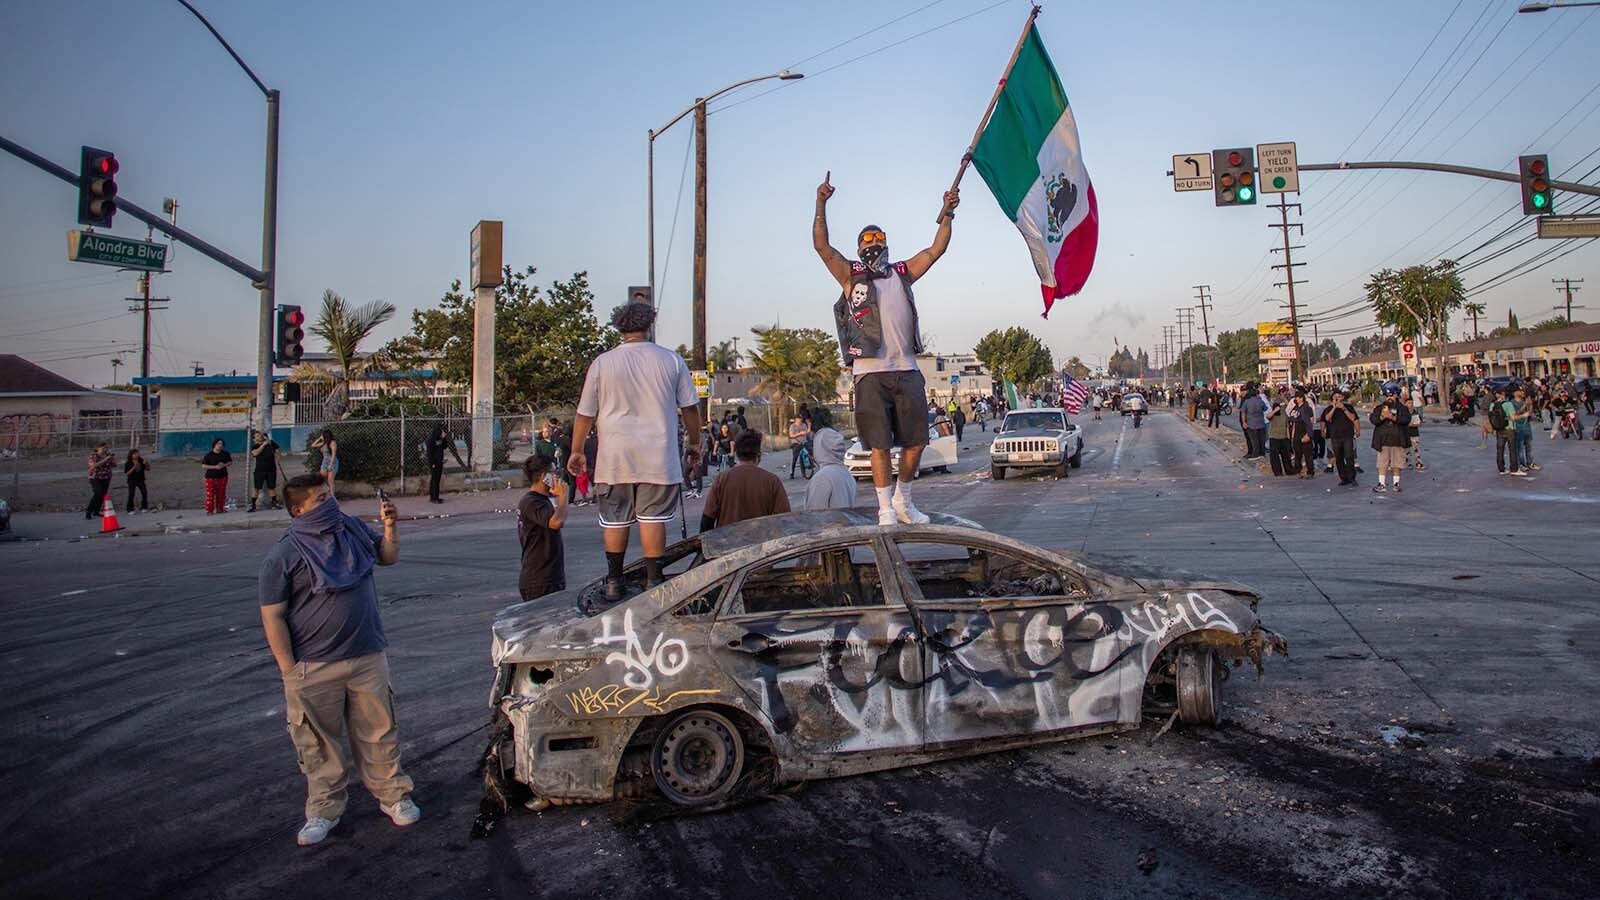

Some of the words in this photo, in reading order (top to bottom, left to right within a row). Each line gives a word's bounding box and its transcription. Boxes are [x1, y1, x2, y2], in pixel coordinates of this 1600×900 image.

[1267, 157, 1289, 166] YIELD
[1186, 180, 1193, 188] U
[83, 237, 134, 256] Alondra
[137, 245, 164, 260] Blvd
